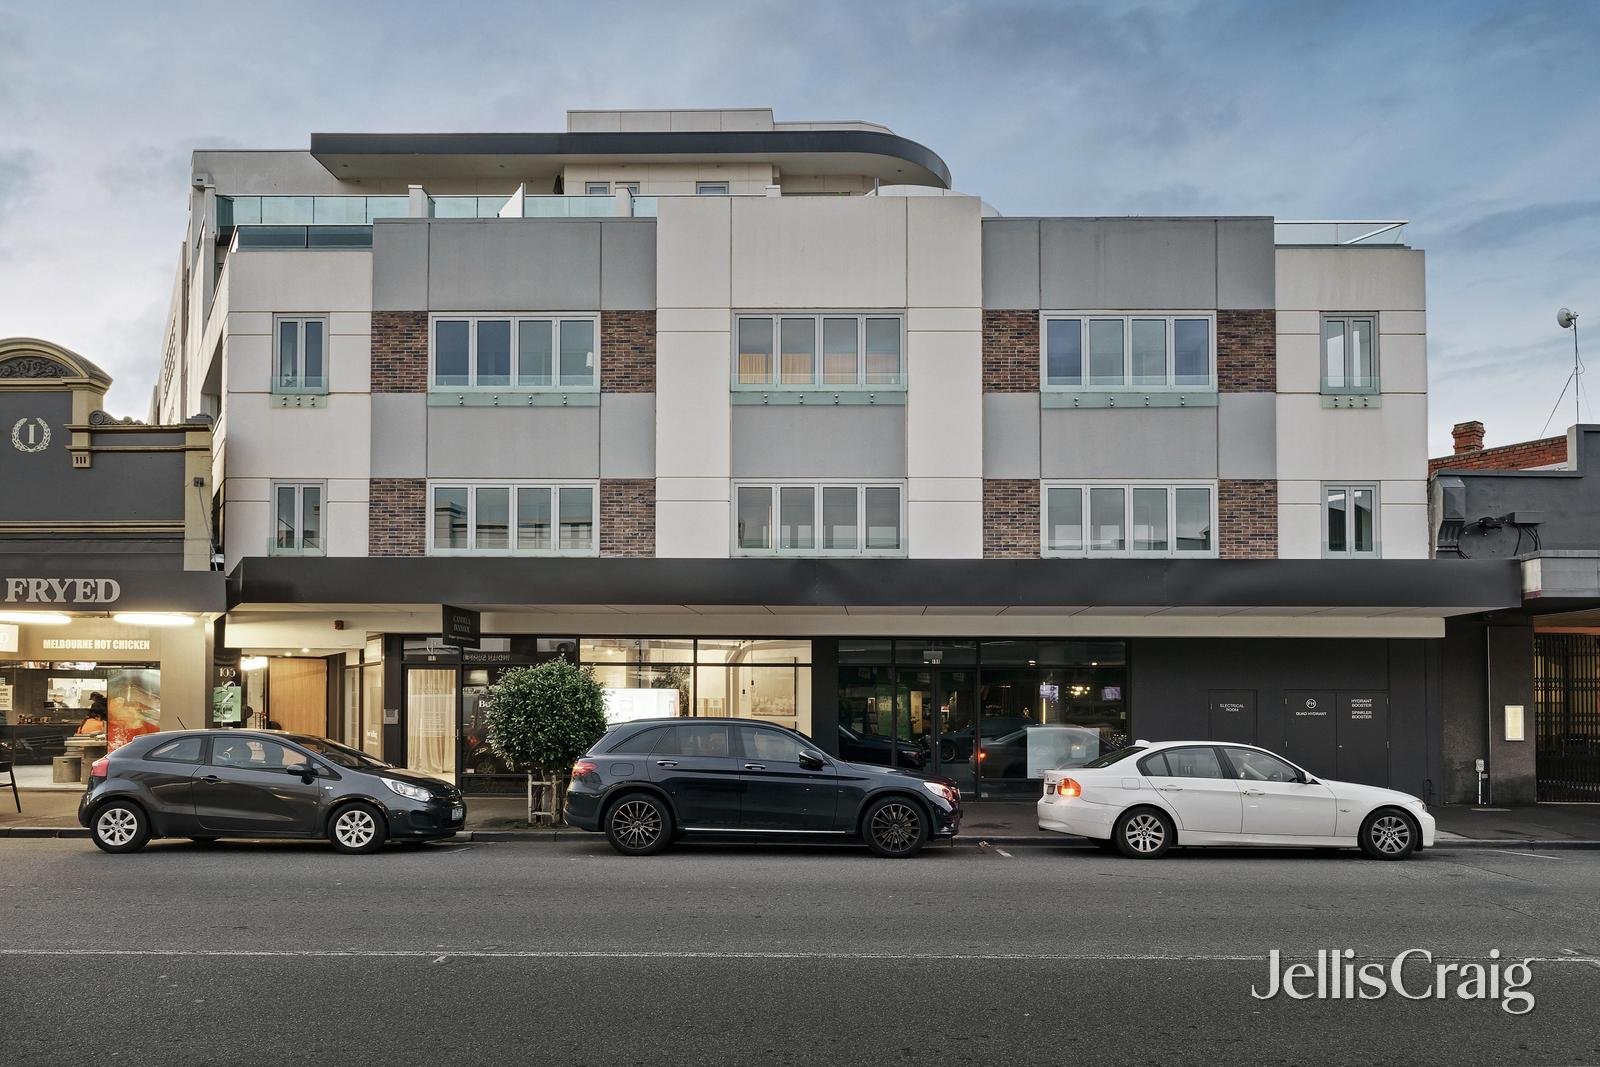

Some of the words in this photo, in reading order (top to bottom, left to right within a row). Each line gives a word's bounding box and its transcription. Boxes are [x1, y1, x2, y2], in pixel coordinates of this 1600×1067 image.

[4, 577, 121, 603] FRYED
[43, 639, 94, 649] MELBOURNE
[94, 639, 112, 650] HOT
[112, 640, 150, 650] CHICKEN
